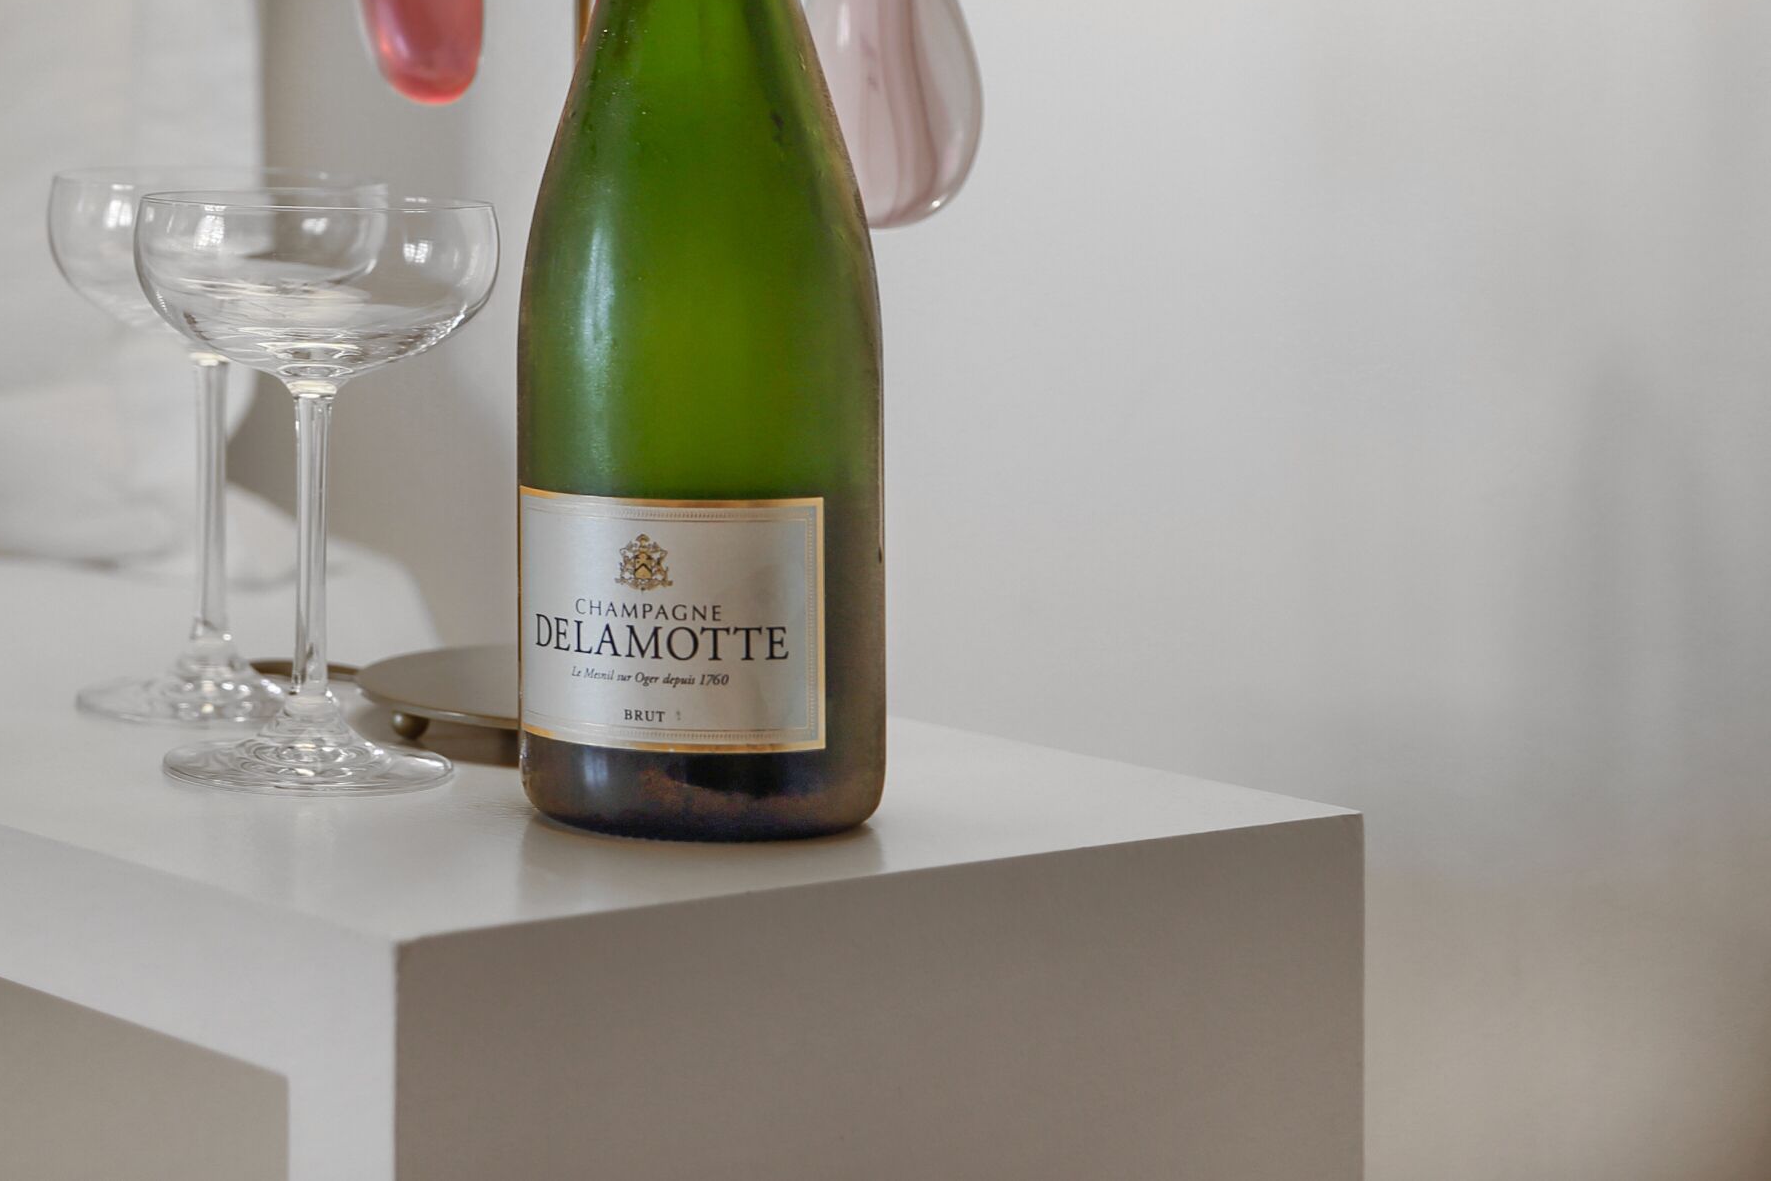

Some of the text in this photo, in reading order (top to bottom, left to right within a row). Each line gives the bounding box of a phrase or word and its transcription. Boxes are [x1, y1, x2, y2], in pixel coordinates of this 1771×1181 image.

[575, 598, 722, 621] CHAMPAGNE
[536, 613, 789, 661] DELAMOTTE
[572, 666, 730, 688] Le Mesnil sur Oger depuis 1760
[624, 709, 666, 722] BRUT
